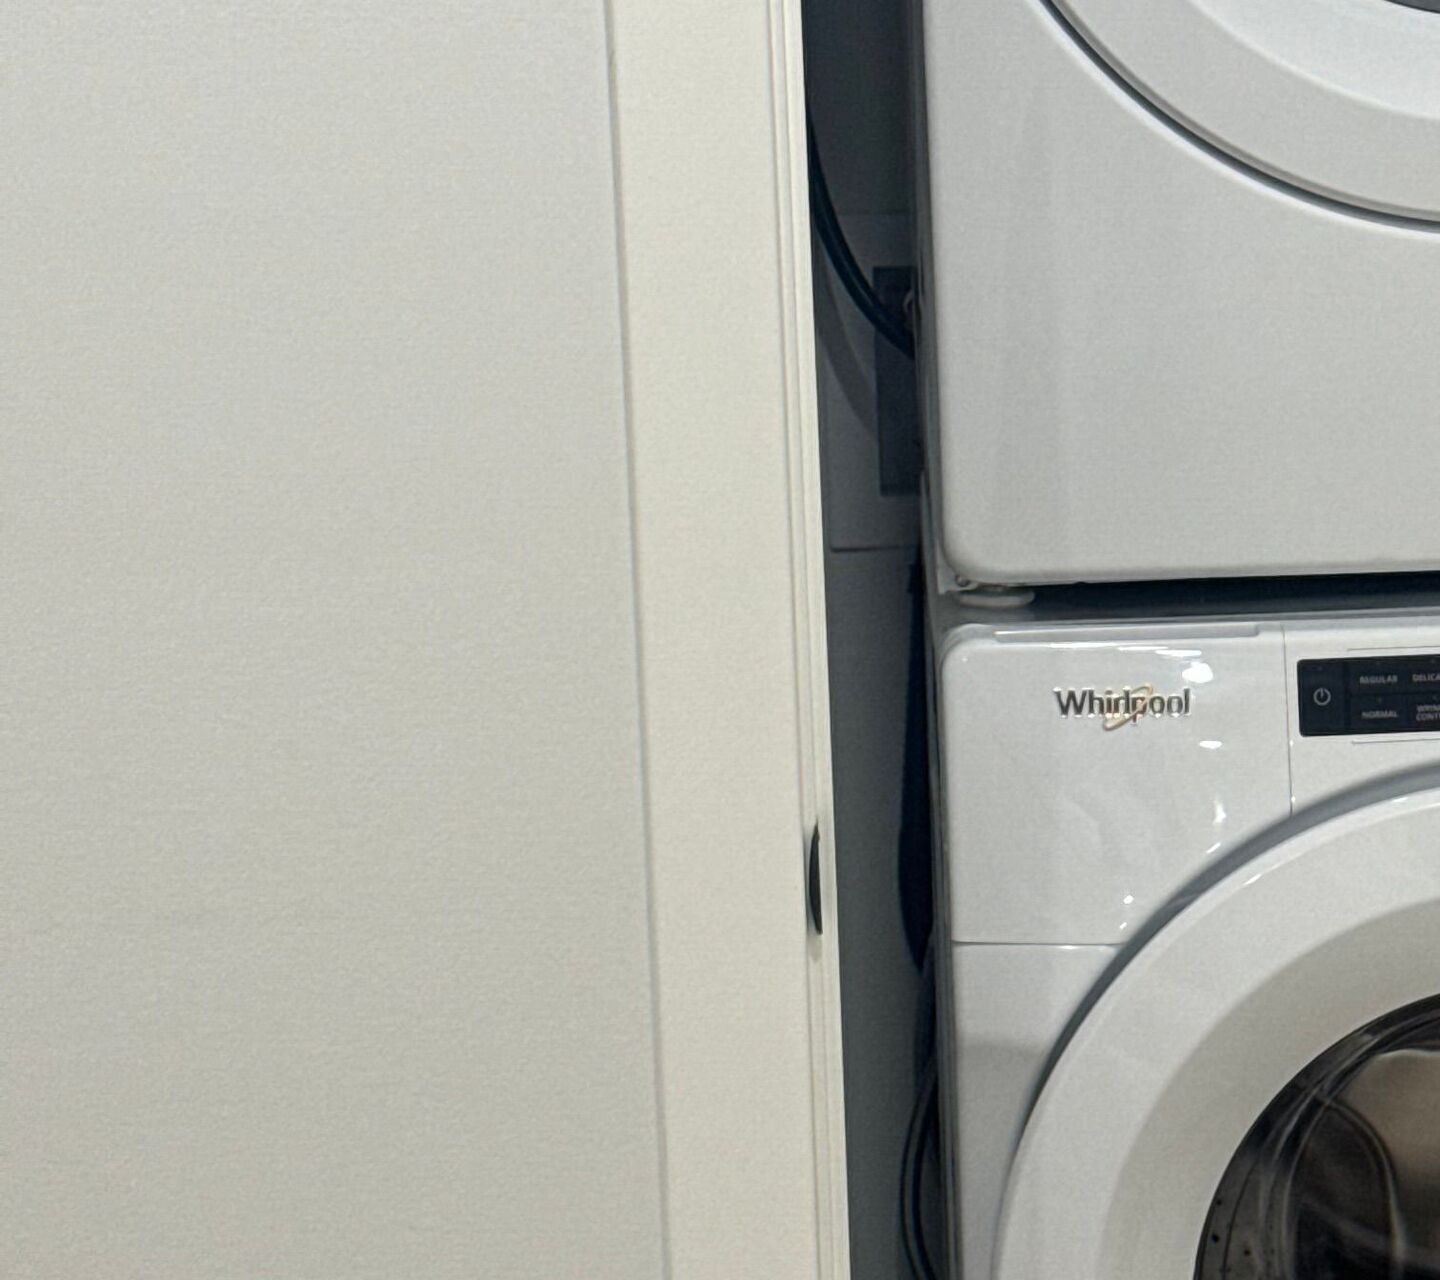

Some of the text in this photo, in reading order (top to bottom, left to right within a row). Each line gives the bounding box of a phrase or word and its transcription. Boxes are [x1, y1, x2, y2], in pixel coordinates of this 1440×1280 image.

[1360, 675, 1398, 684] REGULAR
[1054, 688, 1190, 723] Whirlpool
[1361, 710, 1398, 719] NORMAL
